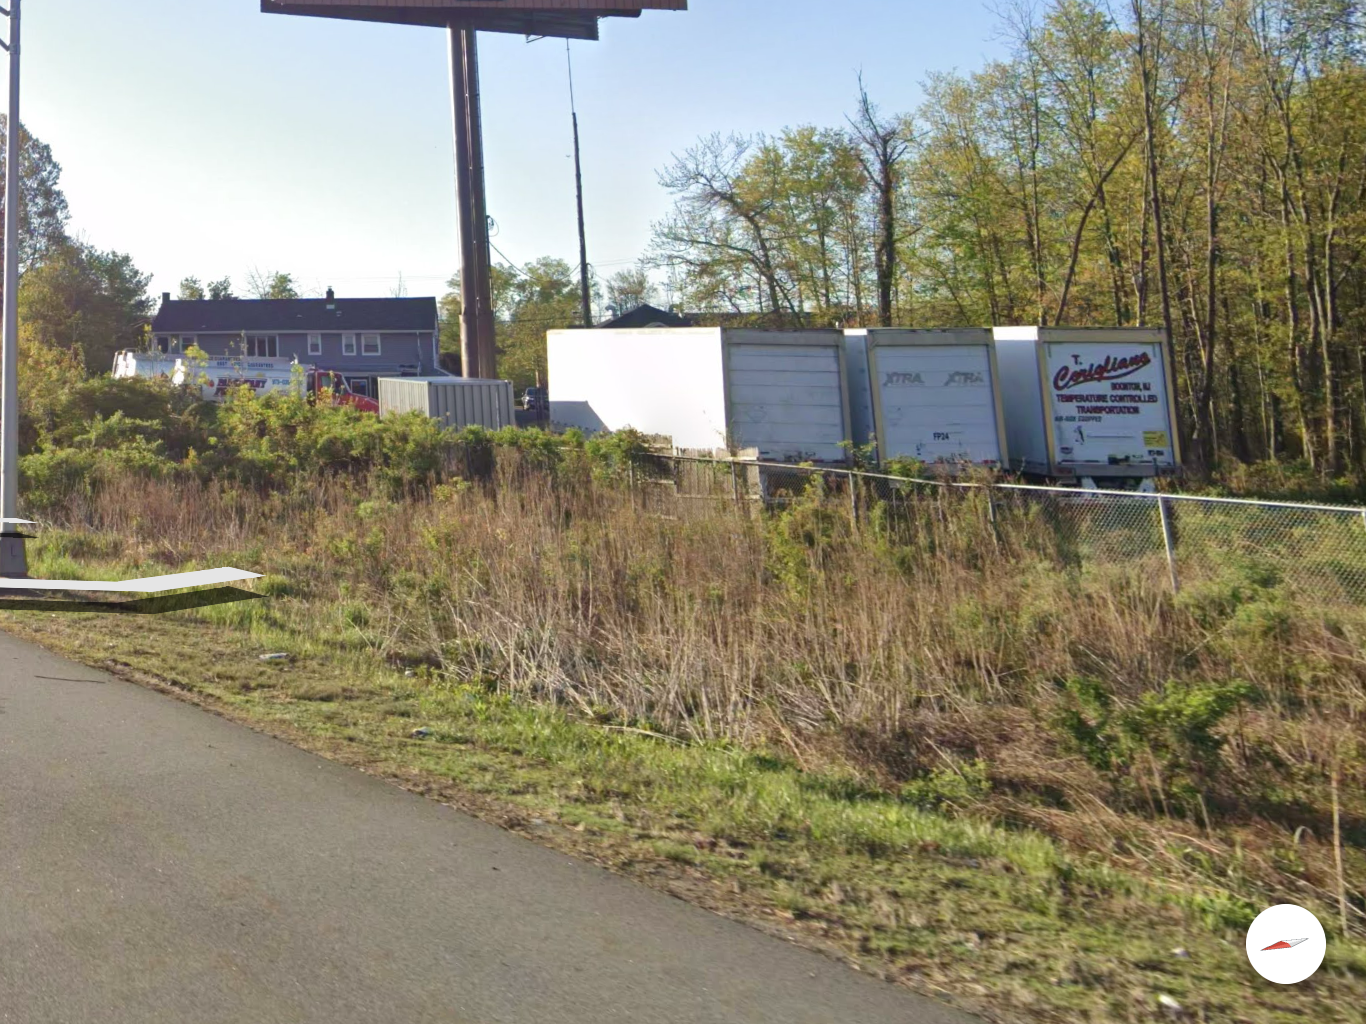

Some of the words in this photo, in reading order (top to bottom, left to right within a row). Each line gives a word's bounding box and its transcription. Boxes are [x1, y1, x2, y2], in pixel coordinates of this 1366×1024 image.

[883, 371, 925, 387] XTRA
[1056, 394, 1108, 403] TEMPERATURE
[1109, 394, 1159, 404] CONTROLLED
[1076, 405, 1140, 415] TRANSPORTATION
[933, 432, 950, 441] FP24
